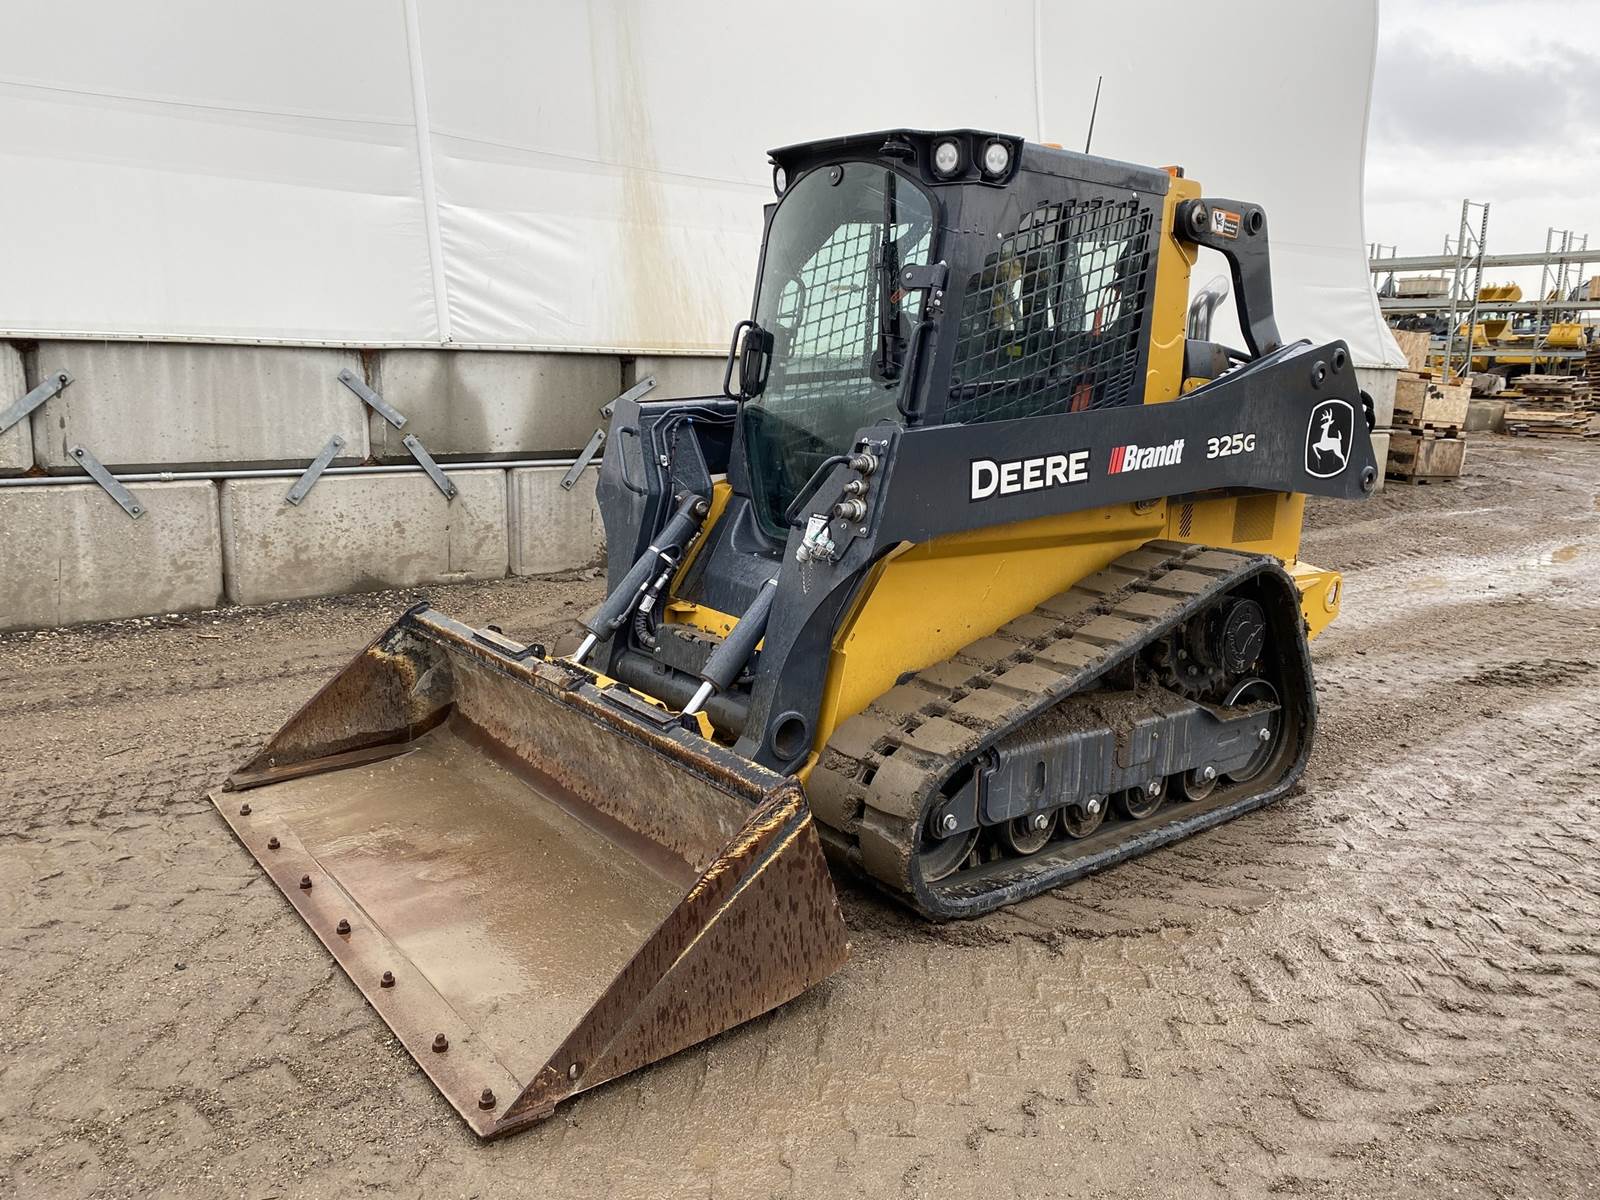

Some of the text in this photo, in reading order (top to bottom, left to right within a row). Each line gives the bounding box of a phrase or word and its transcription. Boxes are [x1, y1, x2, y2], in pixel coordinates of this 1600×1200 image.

[1121, 438, 1185, 473] Brandt
[1206, 433, 1256, 459] 325G
[971, 450, 1089, 500] DEERE
